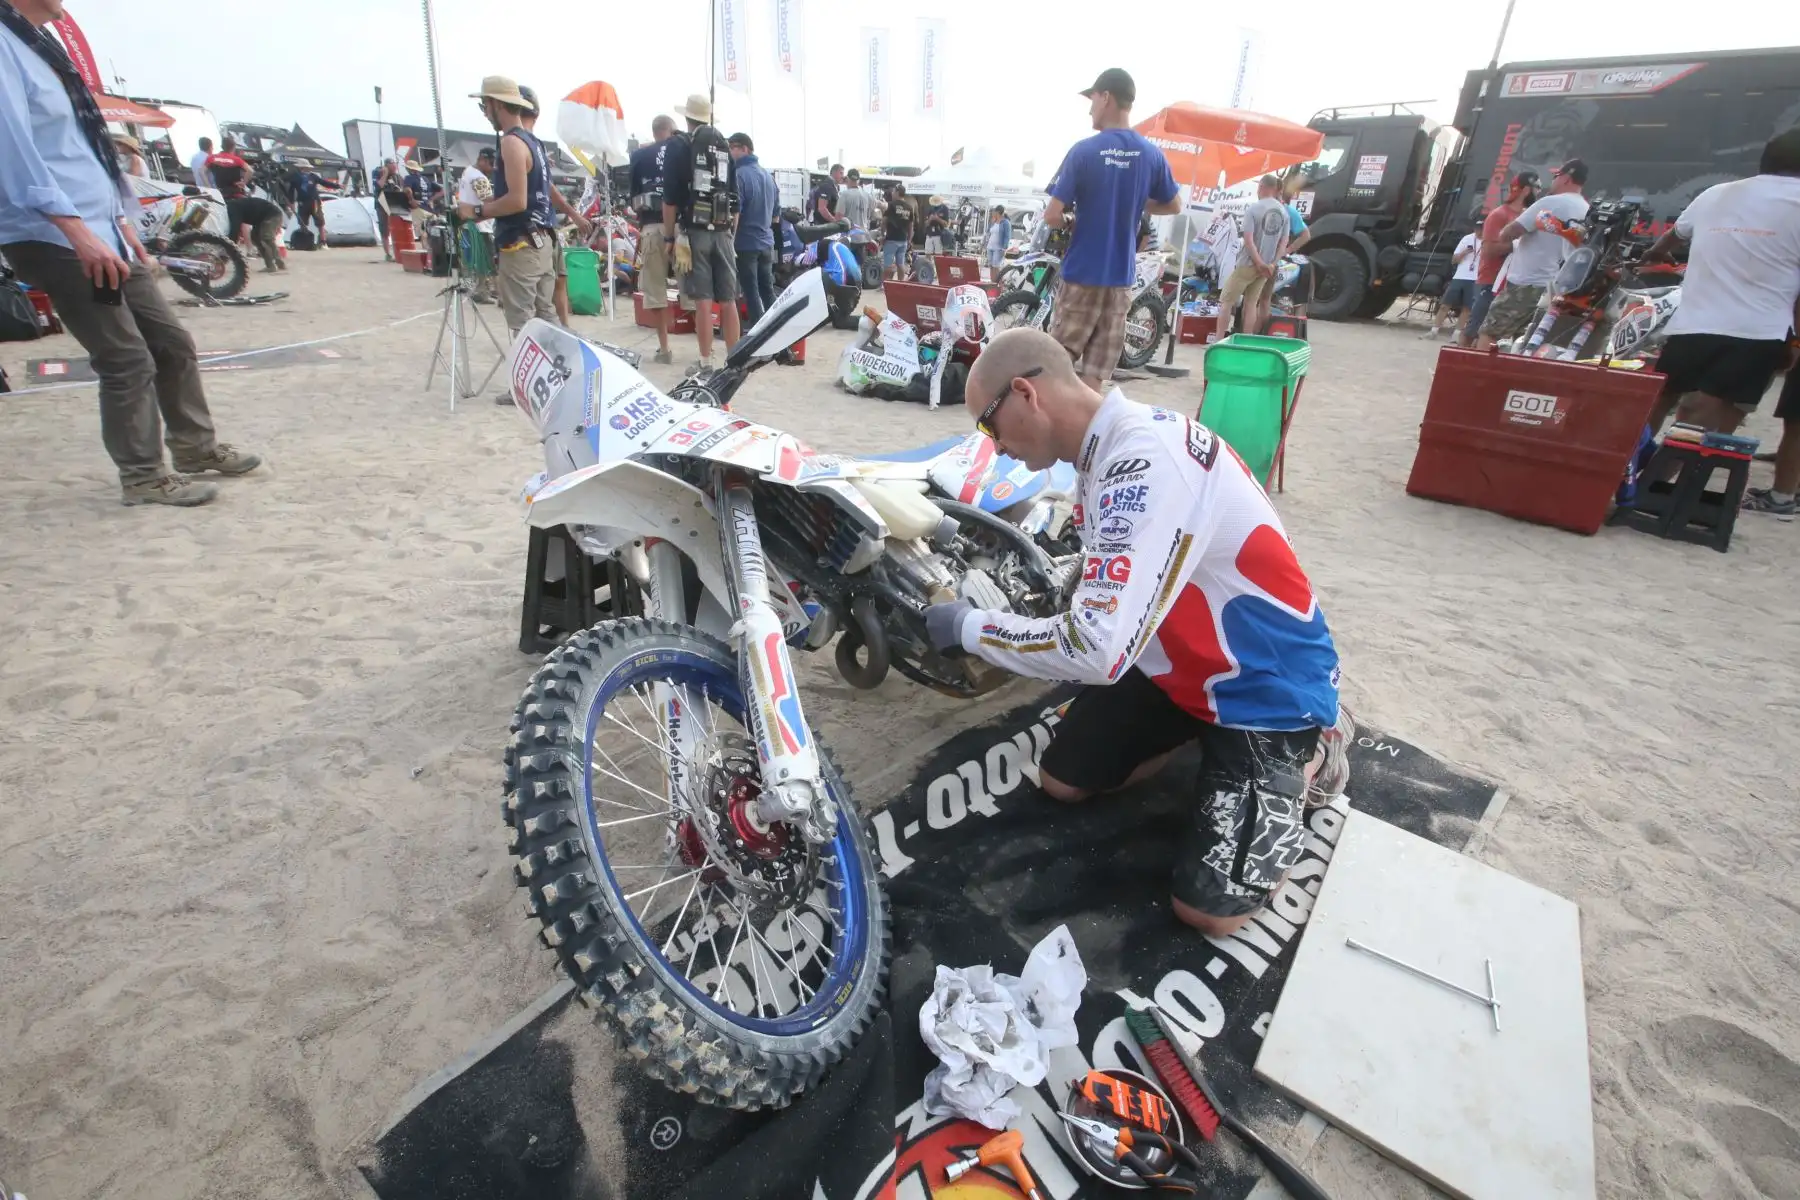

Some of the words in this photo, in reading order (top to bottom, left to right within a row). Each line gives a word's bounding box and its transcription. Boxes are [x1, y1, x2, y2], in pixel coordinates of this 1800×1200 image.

[1530, 79, 1561, 89] MOTUL
[140, 212, 157, 229] 65
[851, 351, 907, 378] SANDERSON
[624, 391, 660, 421] HSF
[624, 403, 674, 440] LOGISTICS
[698, 428, 731, 451] WLM
[1113, 485, 1149, 504] HSF
[1100, 502, 1146, 521] LOSTICS
[634, 654, 659, 667] EXCEL
